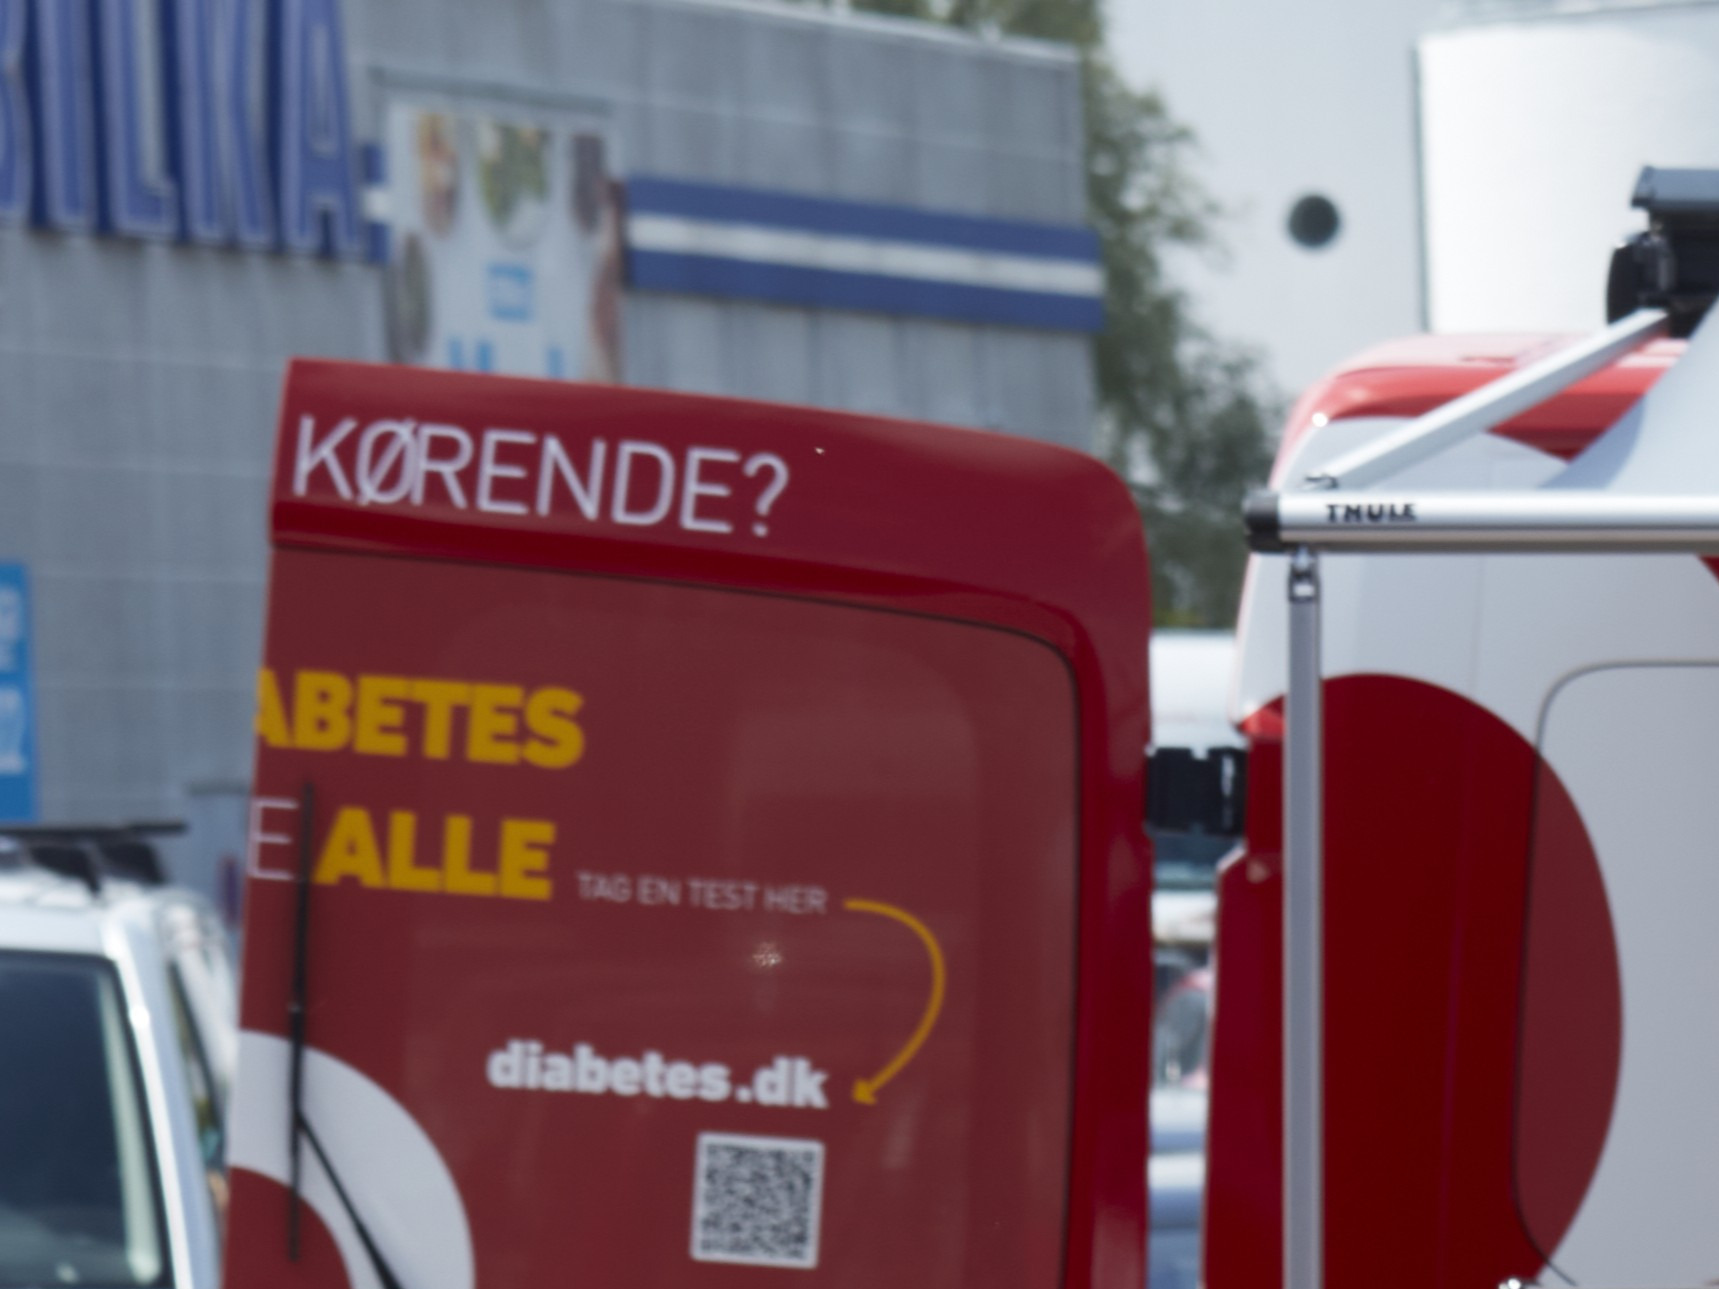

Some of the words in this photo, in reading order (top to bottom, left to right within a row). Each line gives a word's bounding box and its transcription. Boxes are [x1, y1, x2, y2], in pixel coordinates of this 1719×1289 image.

[292, 413, 790, 537] KØRENDE?
[1326, 503, 1417, 523] THULE
[253, 667, 586, 770] ABETES
[314, 805, 556, 901] ALLE
[577, 871, 632, 904] TAG
[636, 876, 682, 906] EN
[687, 879, 760, 911] TEST
[763, 884, 829, 916] HER
[487, 1041, 830, 1109] diabetes.dk
